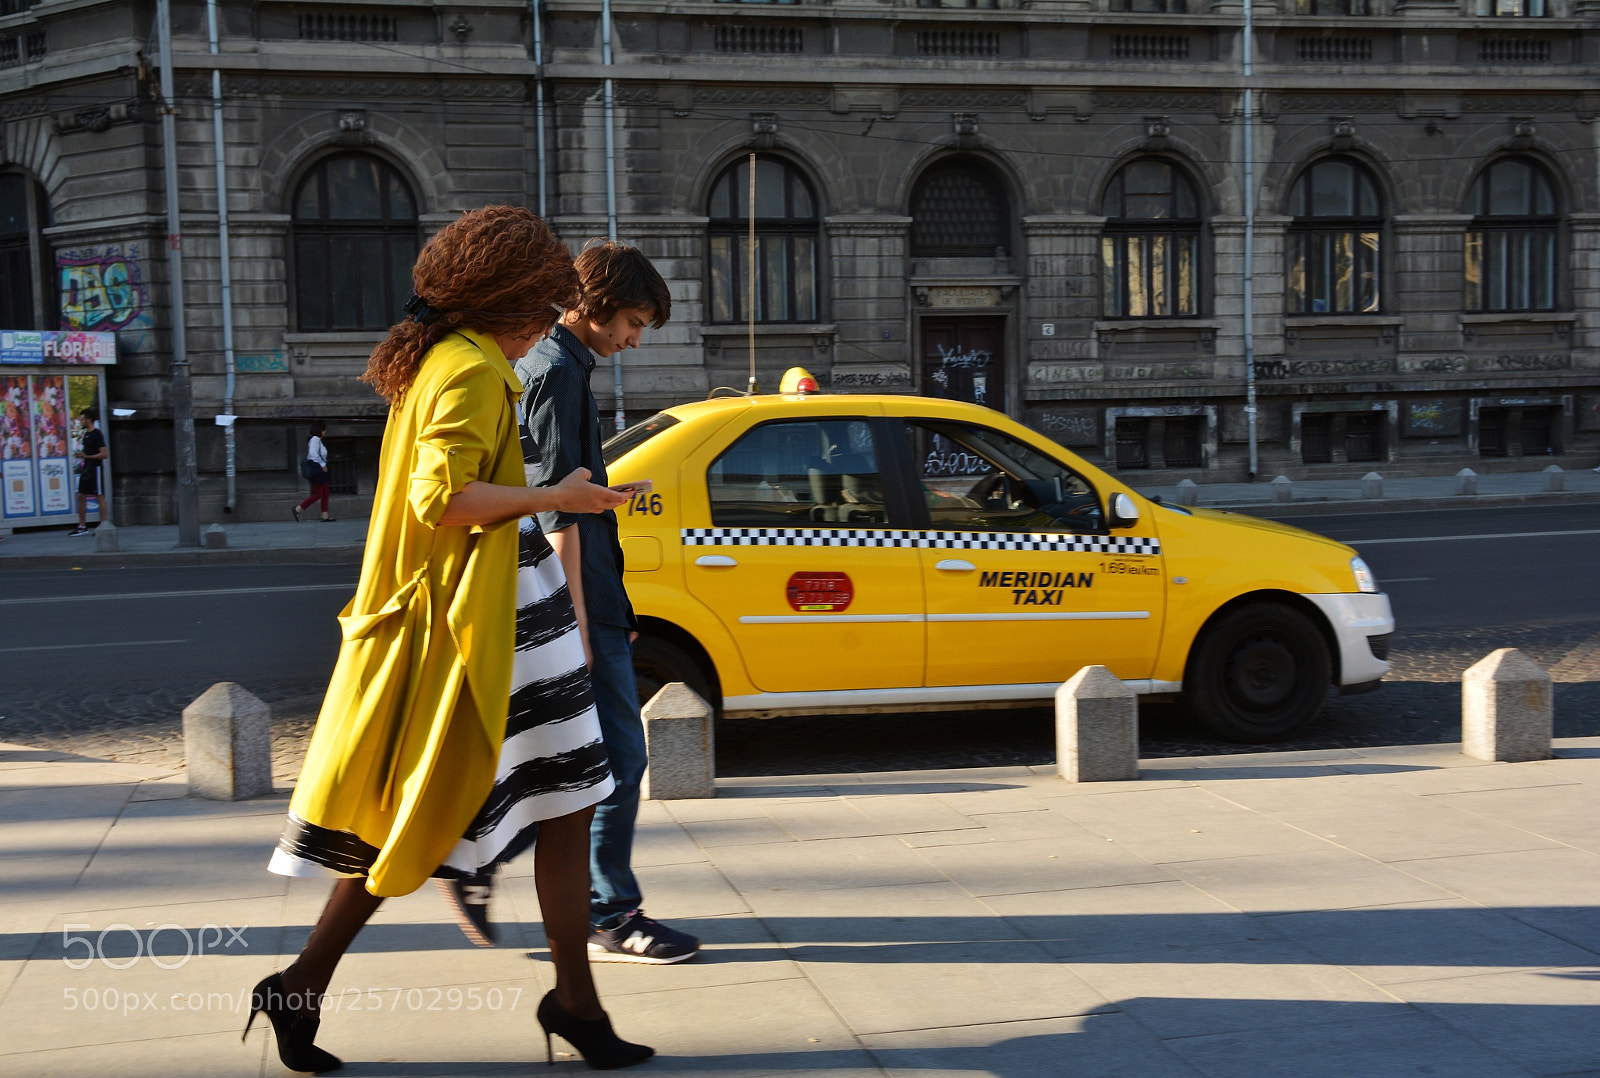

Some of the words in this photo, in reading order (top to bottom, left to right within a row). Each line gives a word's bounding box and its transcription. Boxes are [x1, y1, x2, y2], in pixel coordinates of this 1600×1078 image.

[44, 340, 115, 358] FLORARIE
[628, 493, 663, 516] 746
[979, 571, 1094, 588] MERIDIAN
[1012, 590, 1064, 605] TAXI
